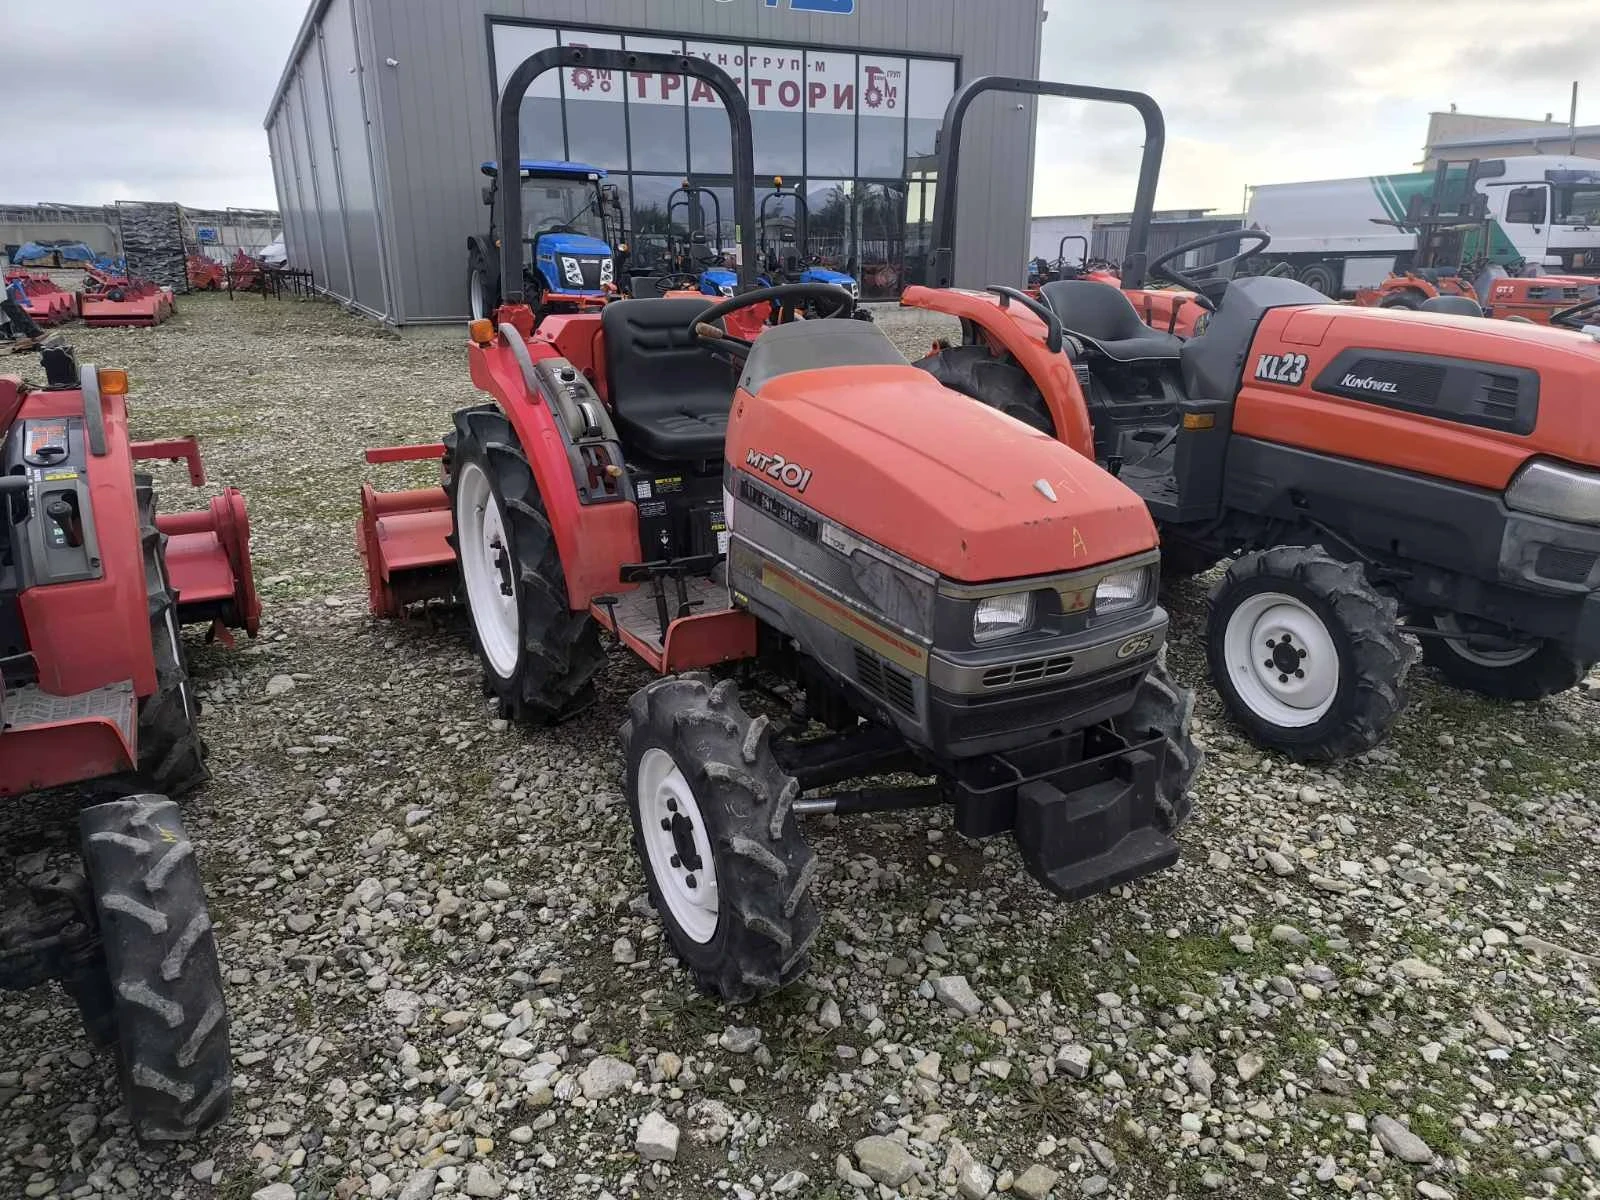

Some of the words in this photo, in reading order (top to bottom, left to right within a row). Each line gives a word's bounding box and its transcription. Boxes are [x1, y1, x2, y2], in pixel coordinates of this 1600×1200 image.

[631, 72, 854, 111] ТРАТОРИ
[1254, 351, 1309, 385] KL23
[745, 448, 813, 494] MT201
[1072, 526, 1088, 559] A
